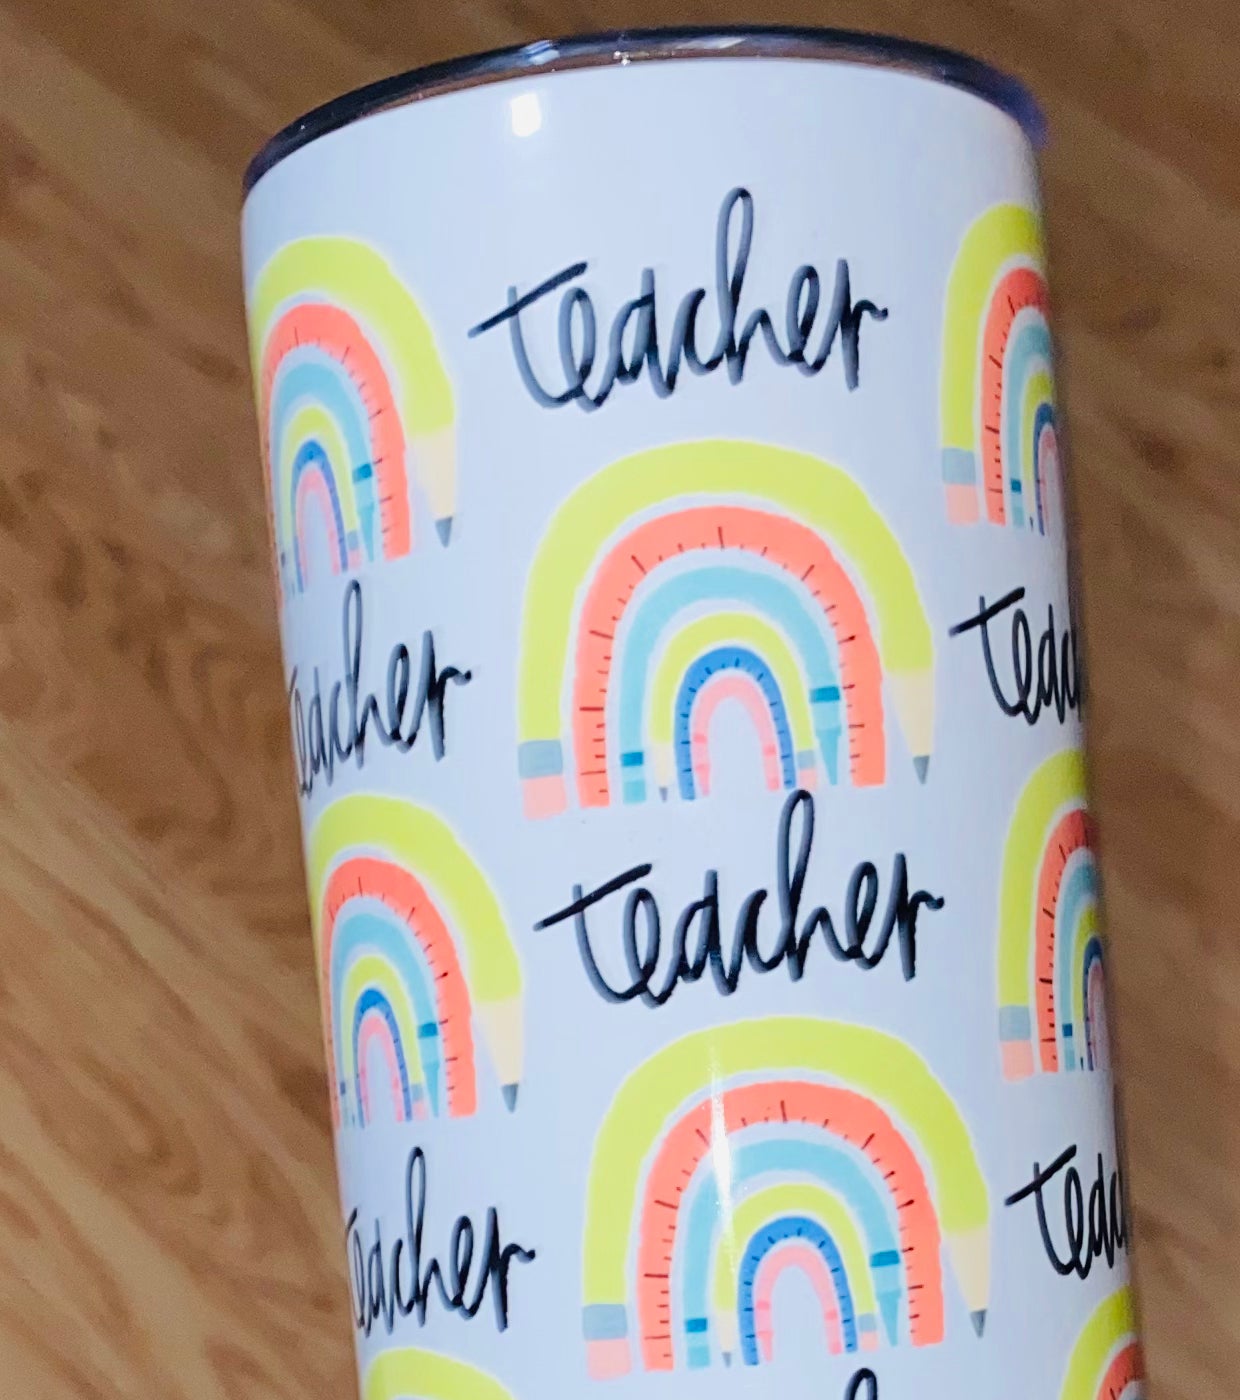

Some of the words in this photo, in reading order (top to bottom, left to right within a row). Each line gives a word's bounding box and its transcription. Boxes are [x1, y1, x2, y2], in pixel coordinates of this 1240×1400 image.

[468, 187, 888, 411] teacher
[290, 579, 472, 799] eacher
[533, 789, 945, 1008] teacher
[345, 1146, 536, 1339] eacher
